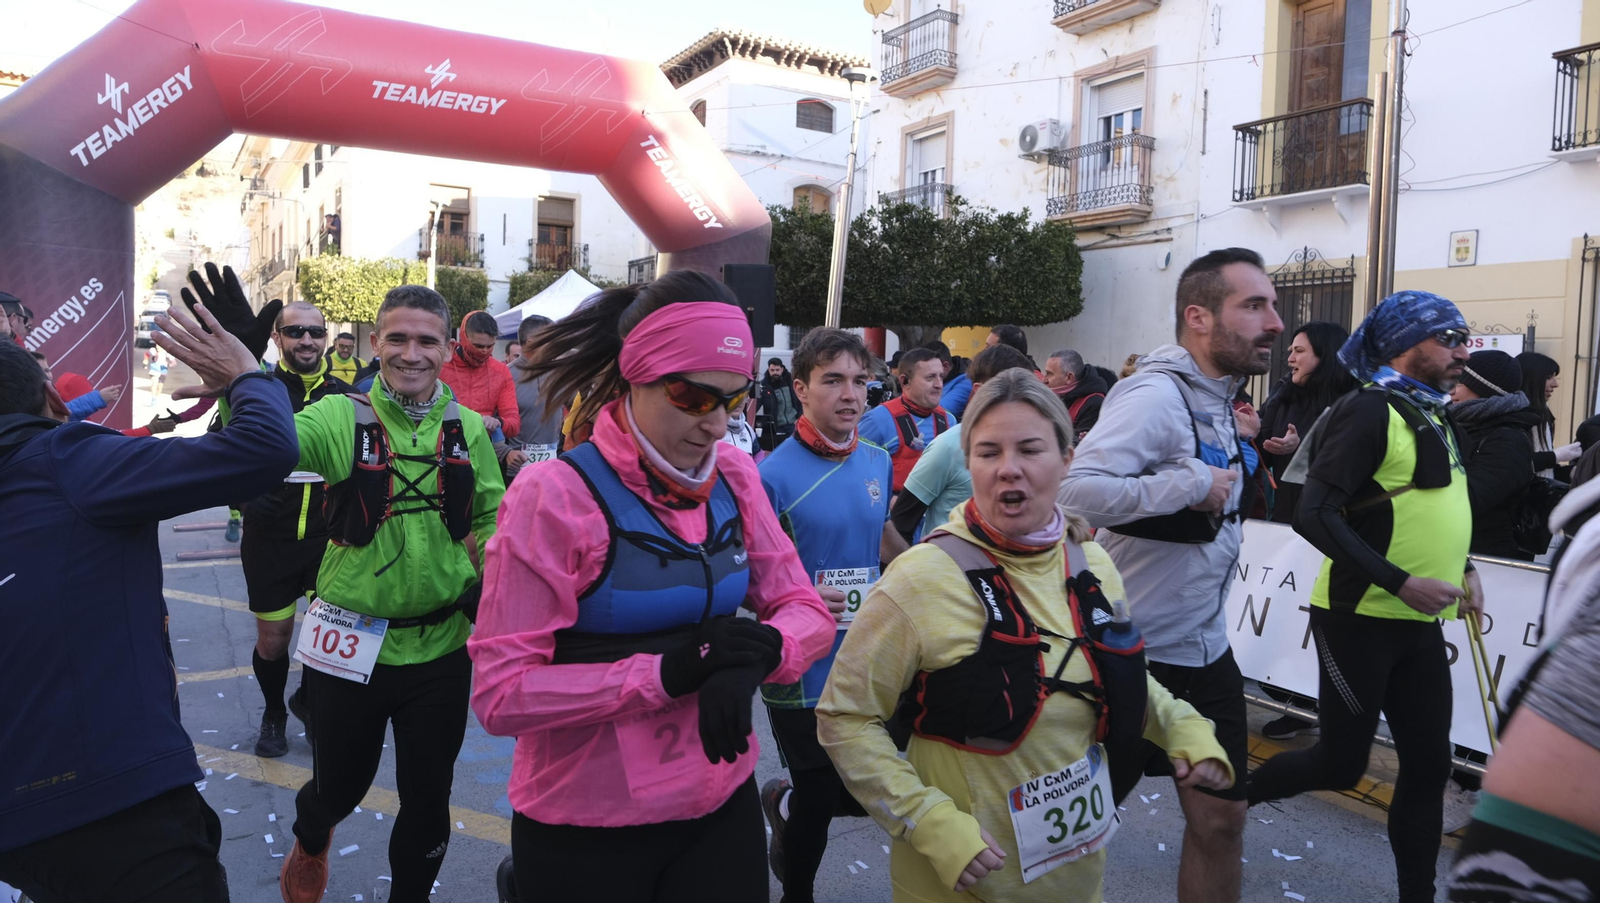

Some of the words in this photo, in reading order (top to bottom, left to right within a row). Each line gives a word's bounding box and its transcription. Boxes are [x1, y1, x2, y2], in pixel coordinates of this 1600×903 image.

[371, 79, 507, 116] TEAMERGY
[69, 64, 194, 167] TEAMERGY
[639, 134, 723, 230] TEAMERGY
[529, 453, 550, 463] 372
[827, 570, 835, 578] IV
[837, 569, 855, 578] CxM
[312, 624, 360, 659] 103
[1024, 796, 1041, 809] LA
[1043, 774, 1091, 803] PÓLVORA
[1026, 779, 1040, 794] IV
[1043, 767, 1072, 787] CxM
[1043, 783, 1104, 844] 320
